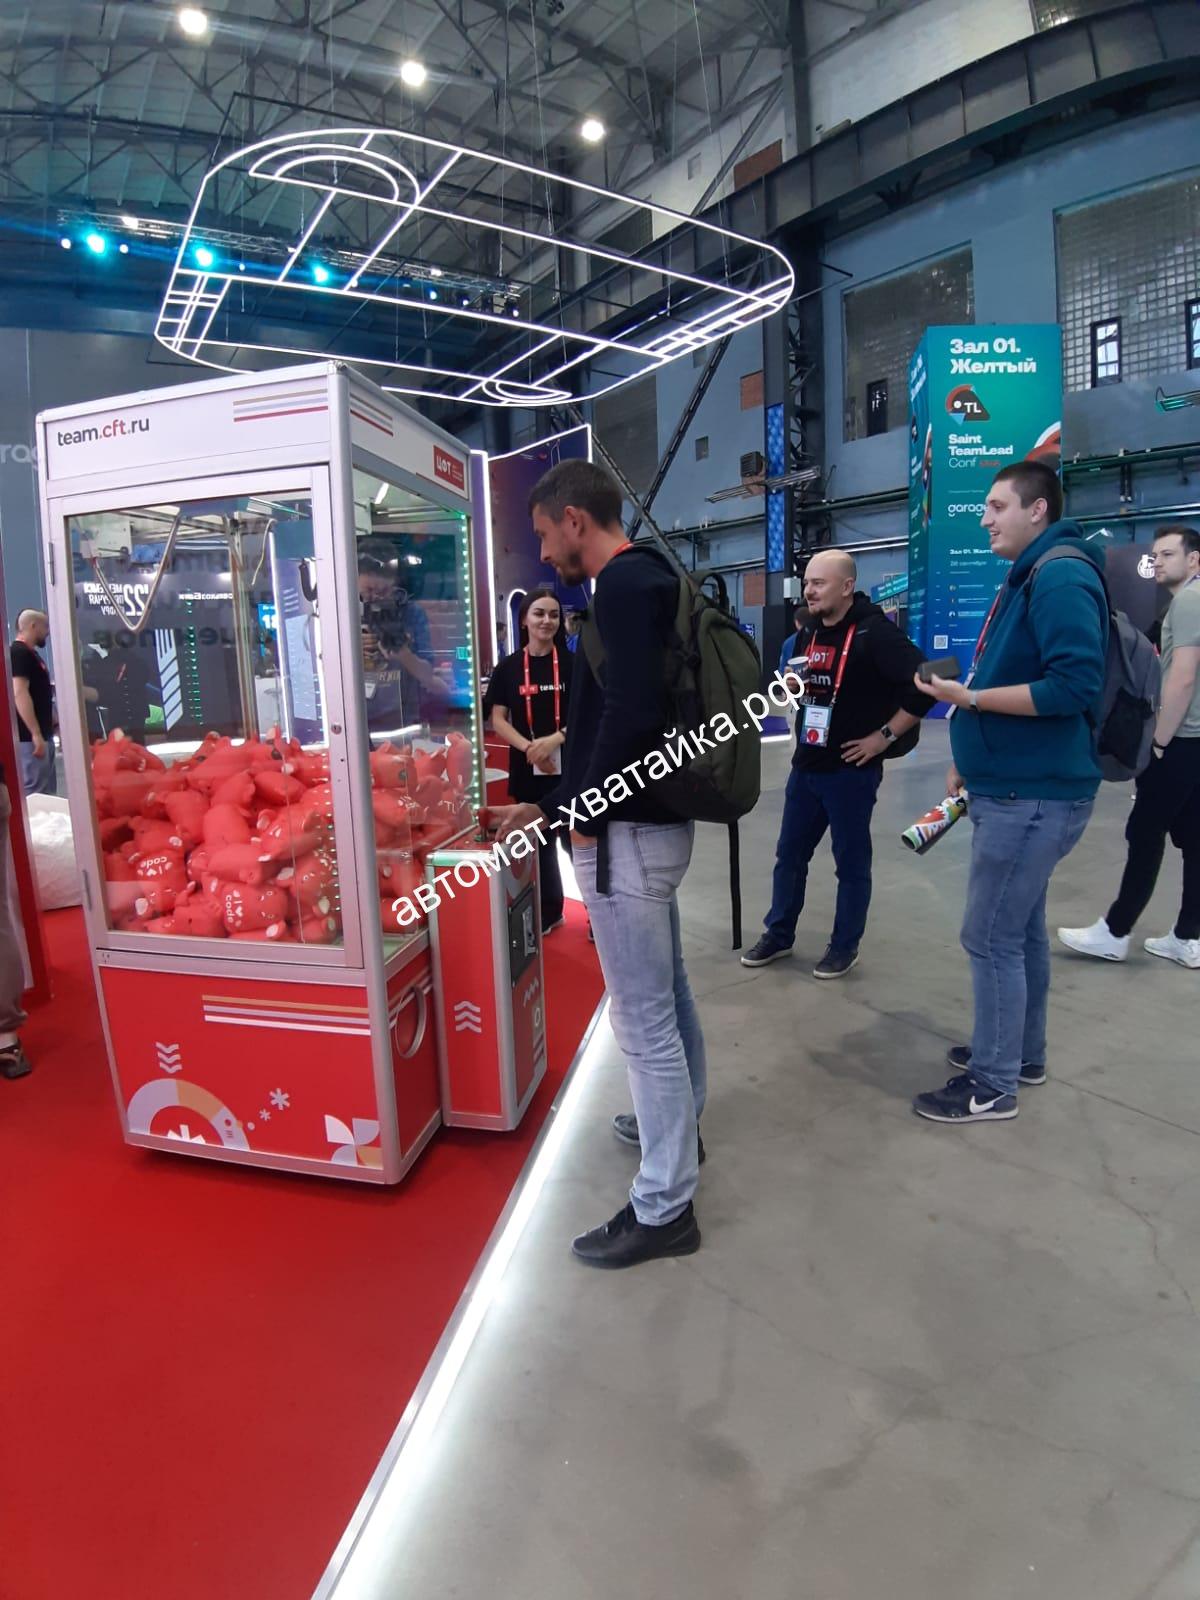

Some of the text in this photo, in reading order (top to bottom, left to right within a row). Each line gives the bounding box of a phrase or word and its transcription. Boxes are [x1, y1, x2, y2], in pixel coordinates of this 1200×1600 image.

[950, 337, 1021, 354] Зал 01.
[950, 357, 1037, 374] Желтый
[964, 402, 982, 413] TL
[57, 418, 150, 447] team.cft.ru
[948, 433, 982, 444] Saint
[948, 445, 1014, 456] TeamLead
[948, 457, 977, 468] Conf
[812, 674, 831, 686] am
[225, 894, 235, 923] code
